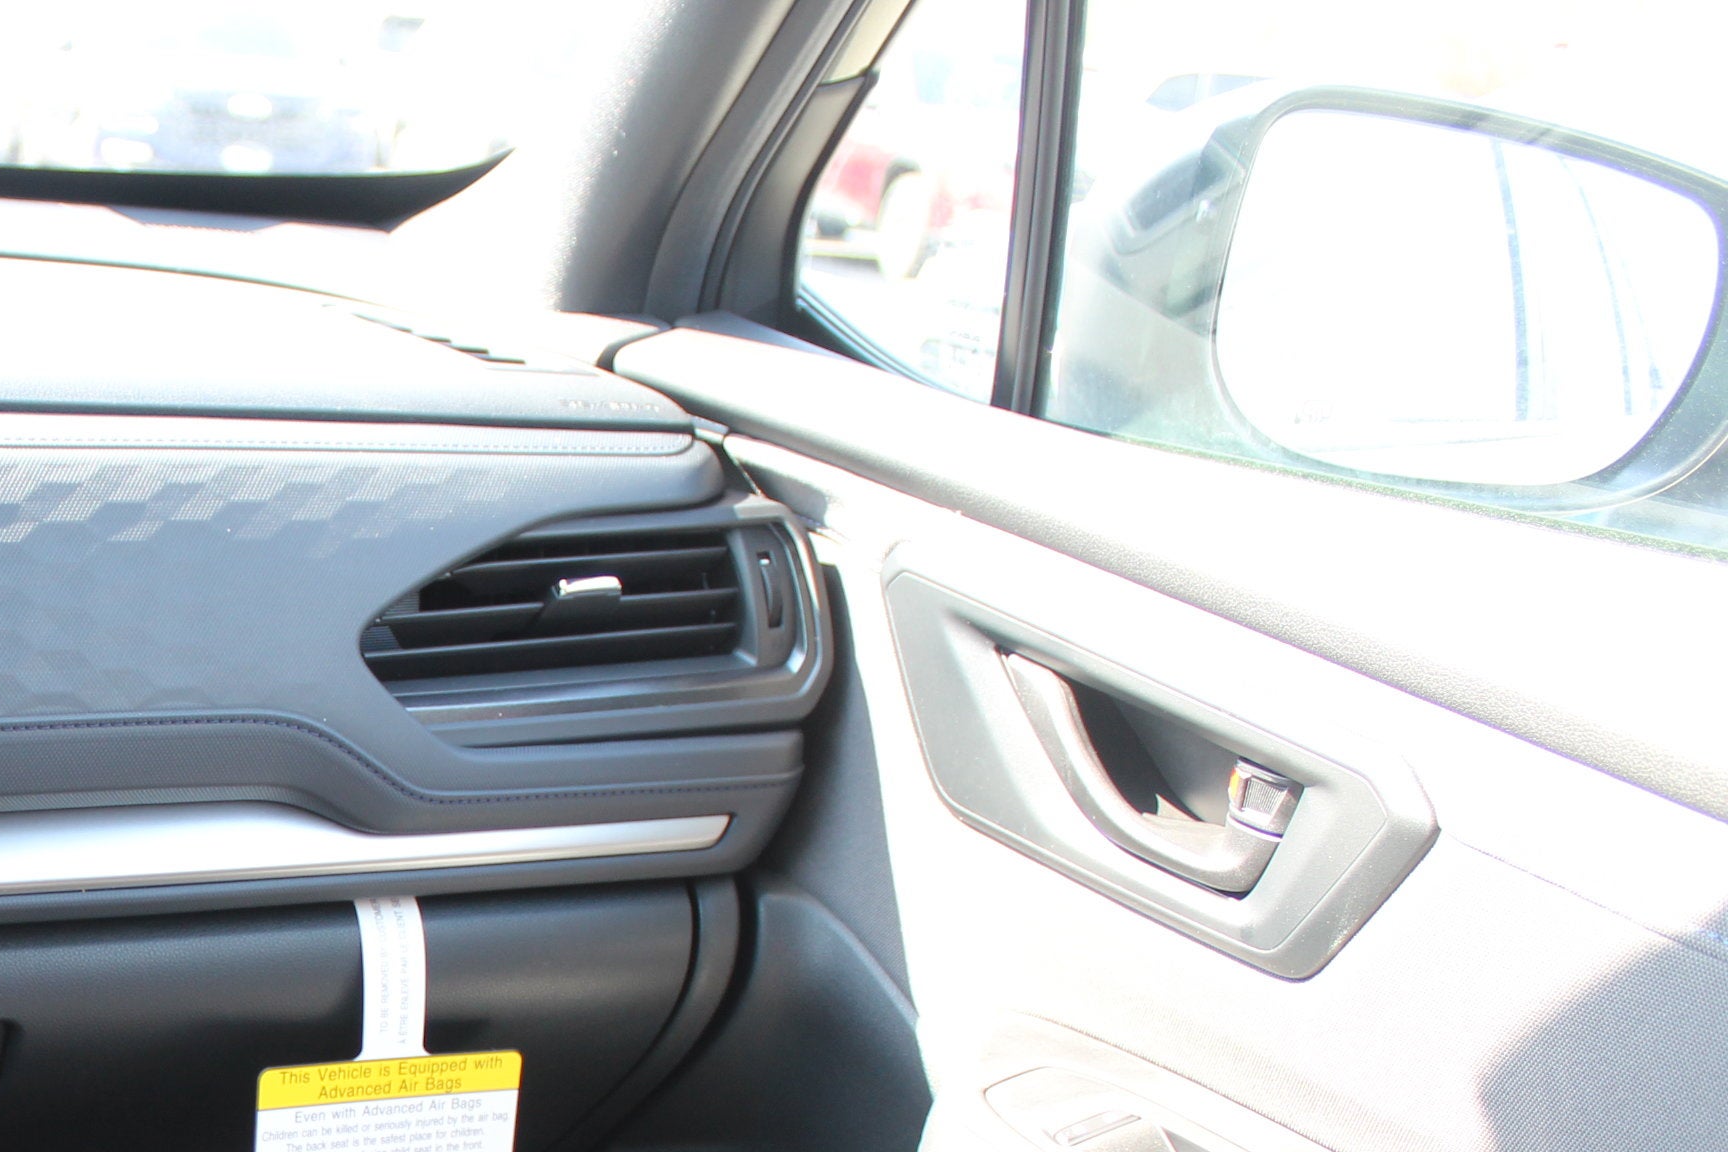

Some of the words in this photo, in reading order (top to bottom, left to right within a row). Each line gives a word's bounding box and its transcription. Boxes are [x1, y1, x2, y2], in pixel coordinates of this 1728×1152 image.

[280, 1071, 310, 1085] This
[319, 1066, 372, 1081] Vehicle
[379, 1064, 390, 1077] is
[398, 1058, 467, 1080] Equipped
[474, 1056, 503, 1069] with
[318, 1083, 391, 1100] Advanced
[399, 1080, 418, 1092] Air
[426, 1077, 462, 1094] Bags
[295, 1111, 325, 1123] Even
[332, 1108, 356, 1119] with
[362, 1101, 423, 1117] Advanced
[429, 1100, 445, 1111] Air
[452, 1098, 482, 1111] Bags
[263, 1130, 298, 1142] Children
[302, 1128, 317, 1137] can
[322, 1127, 332, 1135] be
[336, 1124, 358, 1134] killed
[375, 1119, 411, 1131] seriously
[416, 1117, 443, 1128] injured
[447, 1116, 457, 1126] by
[461, 1114, 474, 1123] the
[478, 1113, 488, 1122] air
[287, 1144, 302, 1152] The
[306, 1141, 325, 1151] back
[331, 1139, 348, 1148] seat
[353, 1139, 359, 1147] is
[363, 1137, 376, 1145] the
[381, 1134, 406, 1144] safest
[410, 1132, 432, 1142] place
[436, 1130, 447, 1139] for
[435, 1144, 442, 1152] in
[447, 1143, 459, 1151] the
